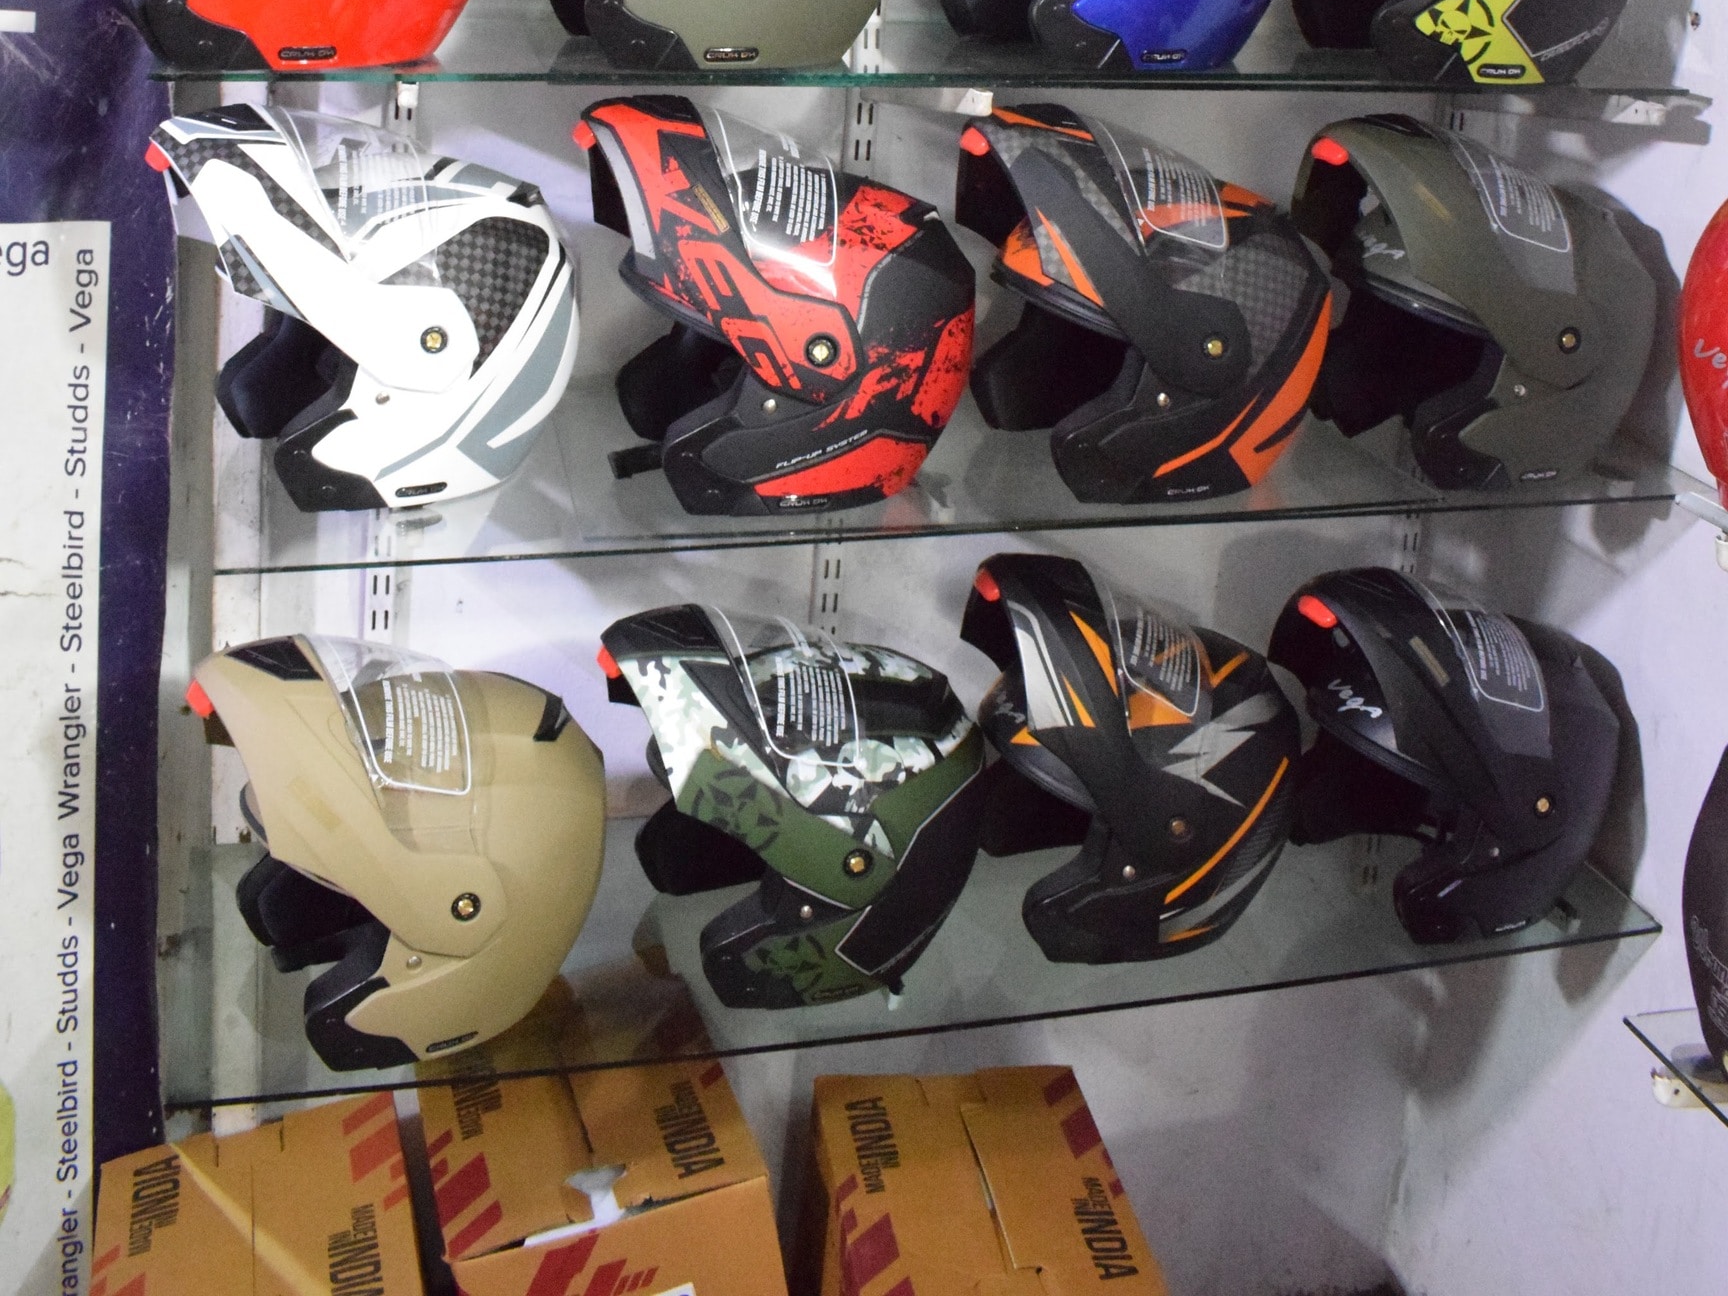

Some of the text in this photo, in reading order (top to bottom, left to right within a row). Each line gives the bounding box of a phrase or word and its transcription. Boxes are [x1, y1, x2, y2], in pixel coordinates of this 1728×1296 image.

[69, 249, 99, 333] Vega
[65, 365, 90, 477] Studds
[60, 510, 85, 653] Steelbird
[58, 682, 86, 821] Wrangler
[57, 833, 85, 910] Vega
[57, 934, 79, 1035] Studds
[57, 1059, 78, 1184] Steelbird
[659, 1112, 725, 1180] INDIA
[844, 1097, 899, 1160] INDIA
[131, 1154, 181, 1225] INDIA
[1073, 1210, 1140, 1281] INDIA
